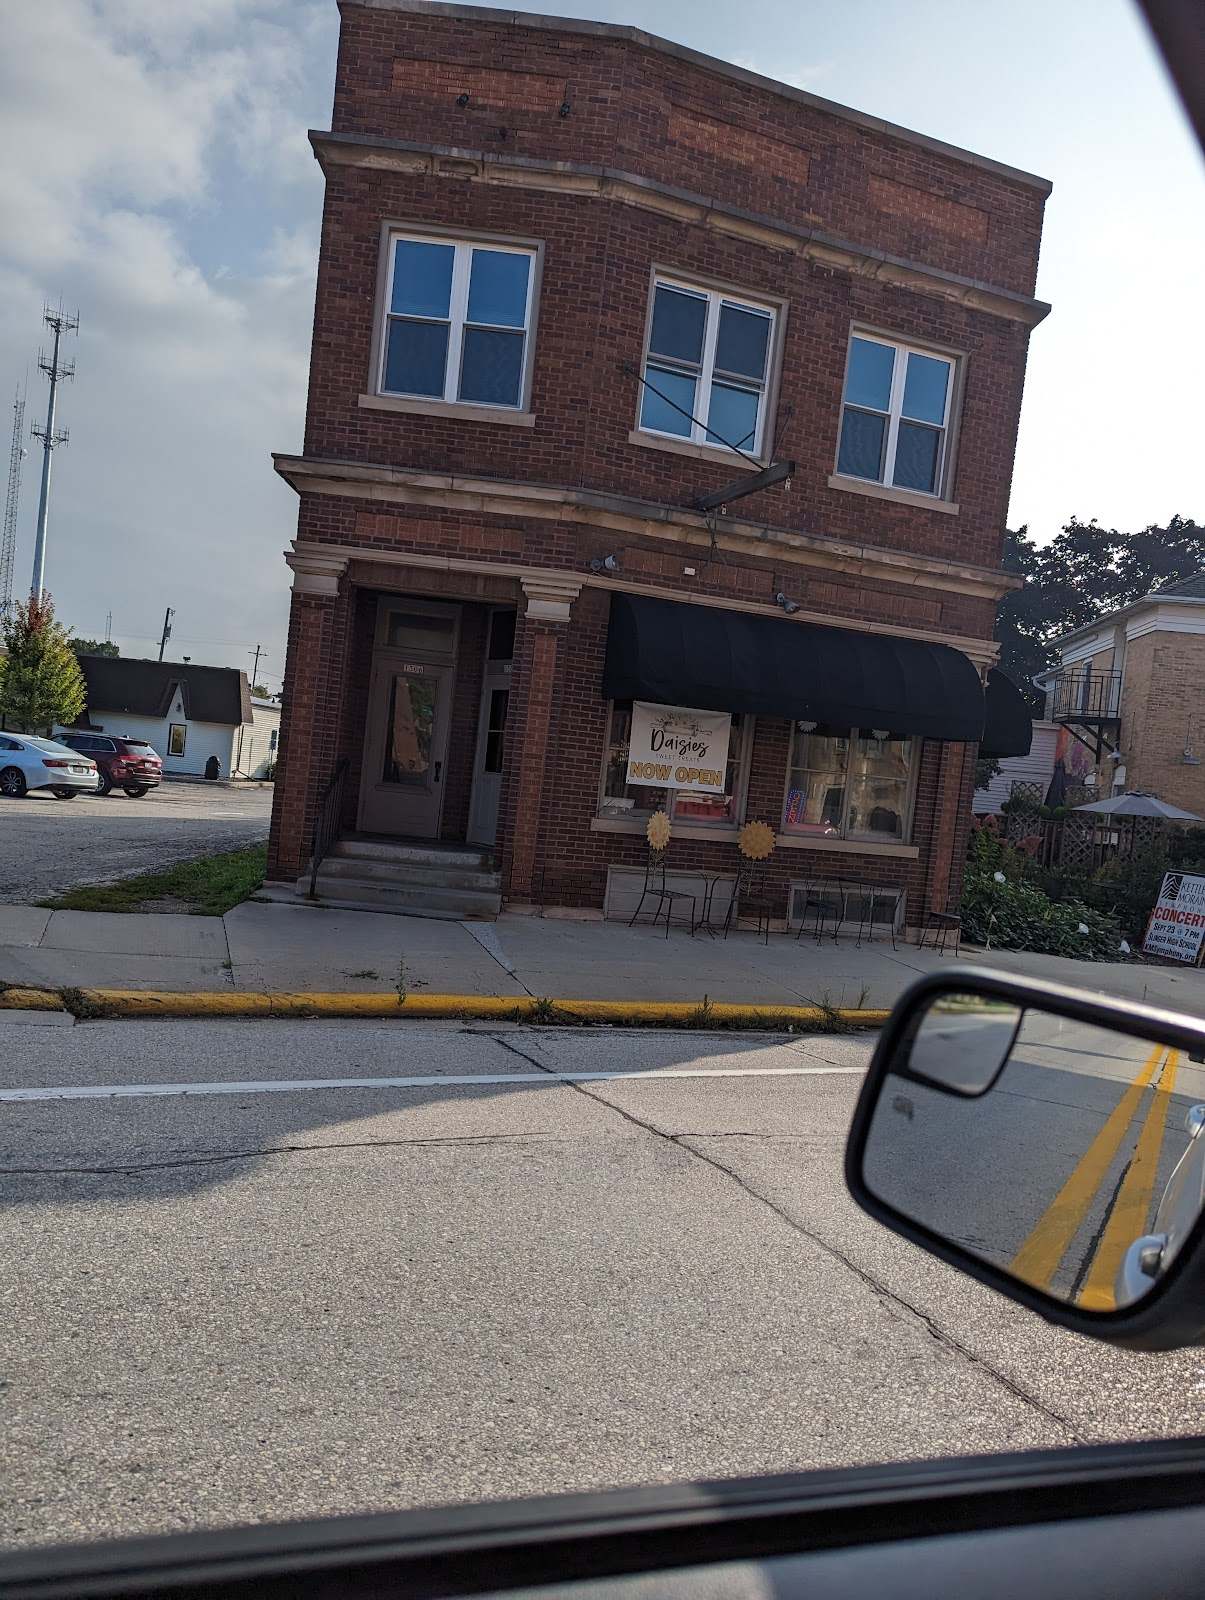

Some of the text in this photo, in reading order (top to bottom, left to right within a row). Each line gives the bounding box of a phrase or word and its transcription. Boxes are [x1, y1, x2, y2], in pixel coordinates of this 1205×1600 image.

[650, 728, 710, 758] Daisies
[629, 761, 723, 786] NOW OPEN
[1154, 907, 1205, 928] CONCERT
[1166, 926, 1176, 934] 23
[1184, 928, 1190, 937] 7
[1189, 930, 1200, 939] PM
